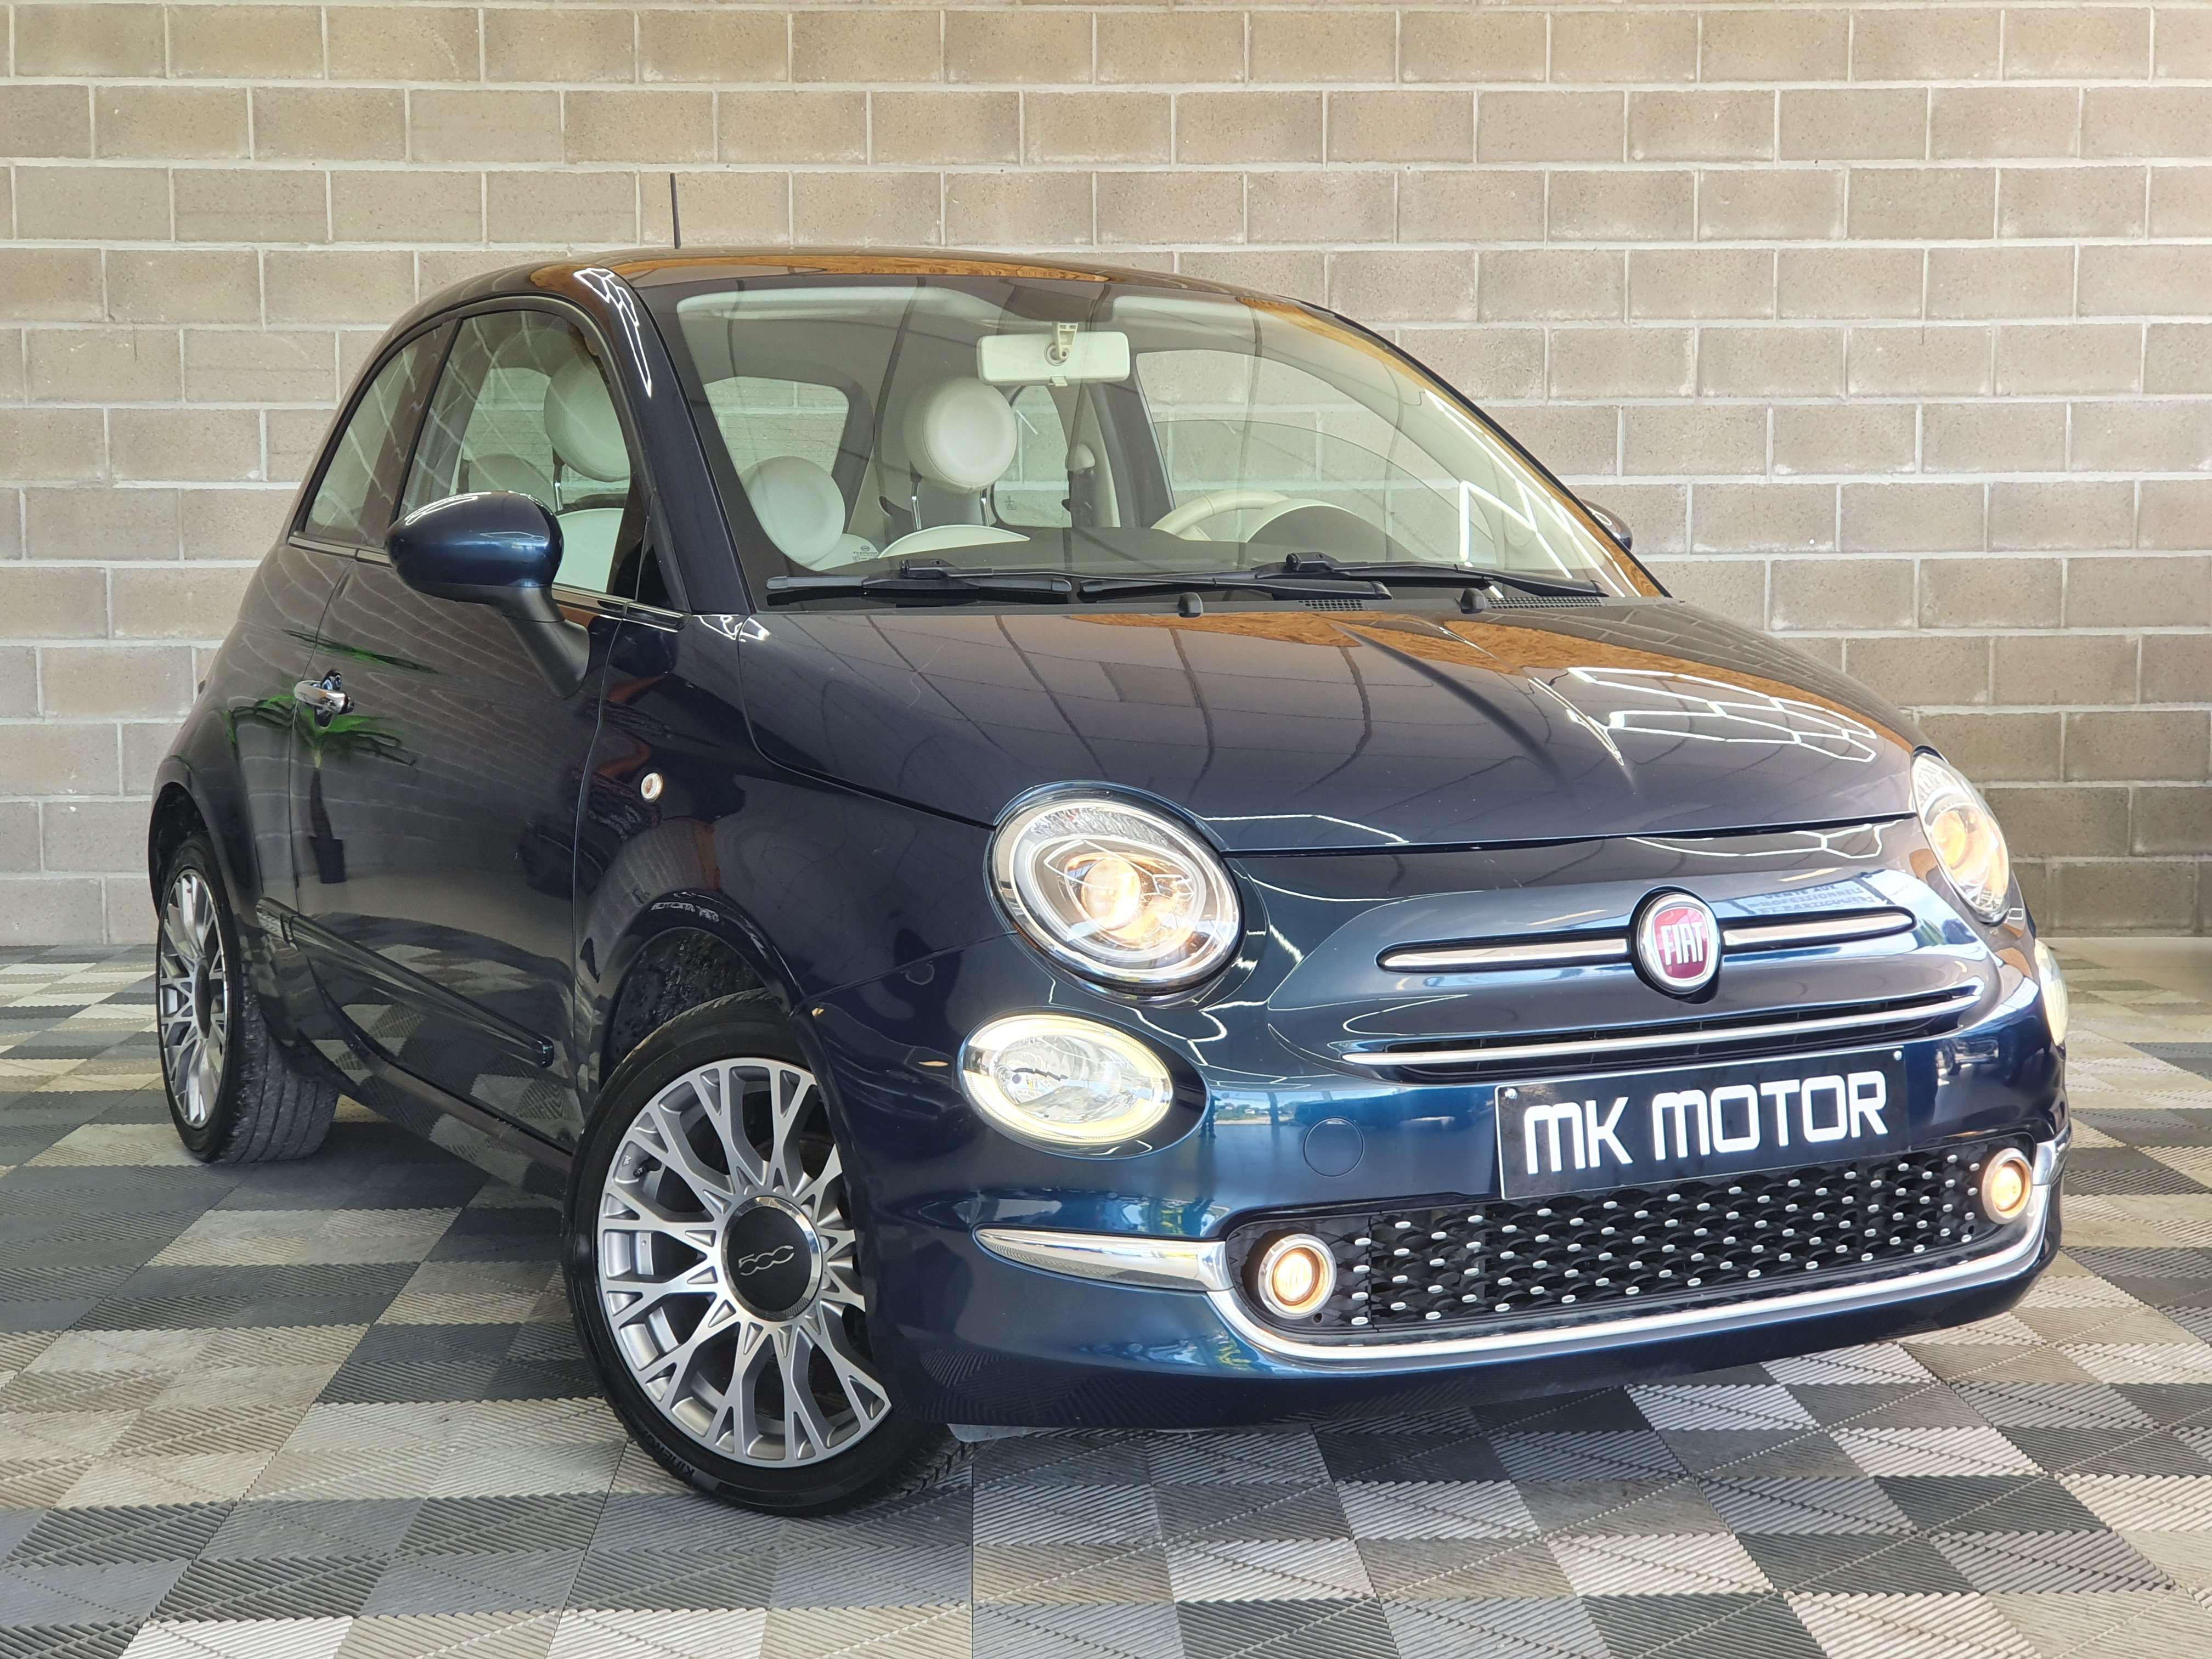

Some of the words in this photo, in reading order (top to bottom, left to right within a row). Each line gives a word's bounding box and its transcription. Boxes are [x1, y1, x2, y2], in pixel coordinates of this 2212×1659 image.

[1660, 921, 1704, 966] FIAT
[1523, 1097, 1633, 1175] MK
[1652, 1070, 1888, 1161] MOTOR
[738, 1245, 795, 1276] 500
